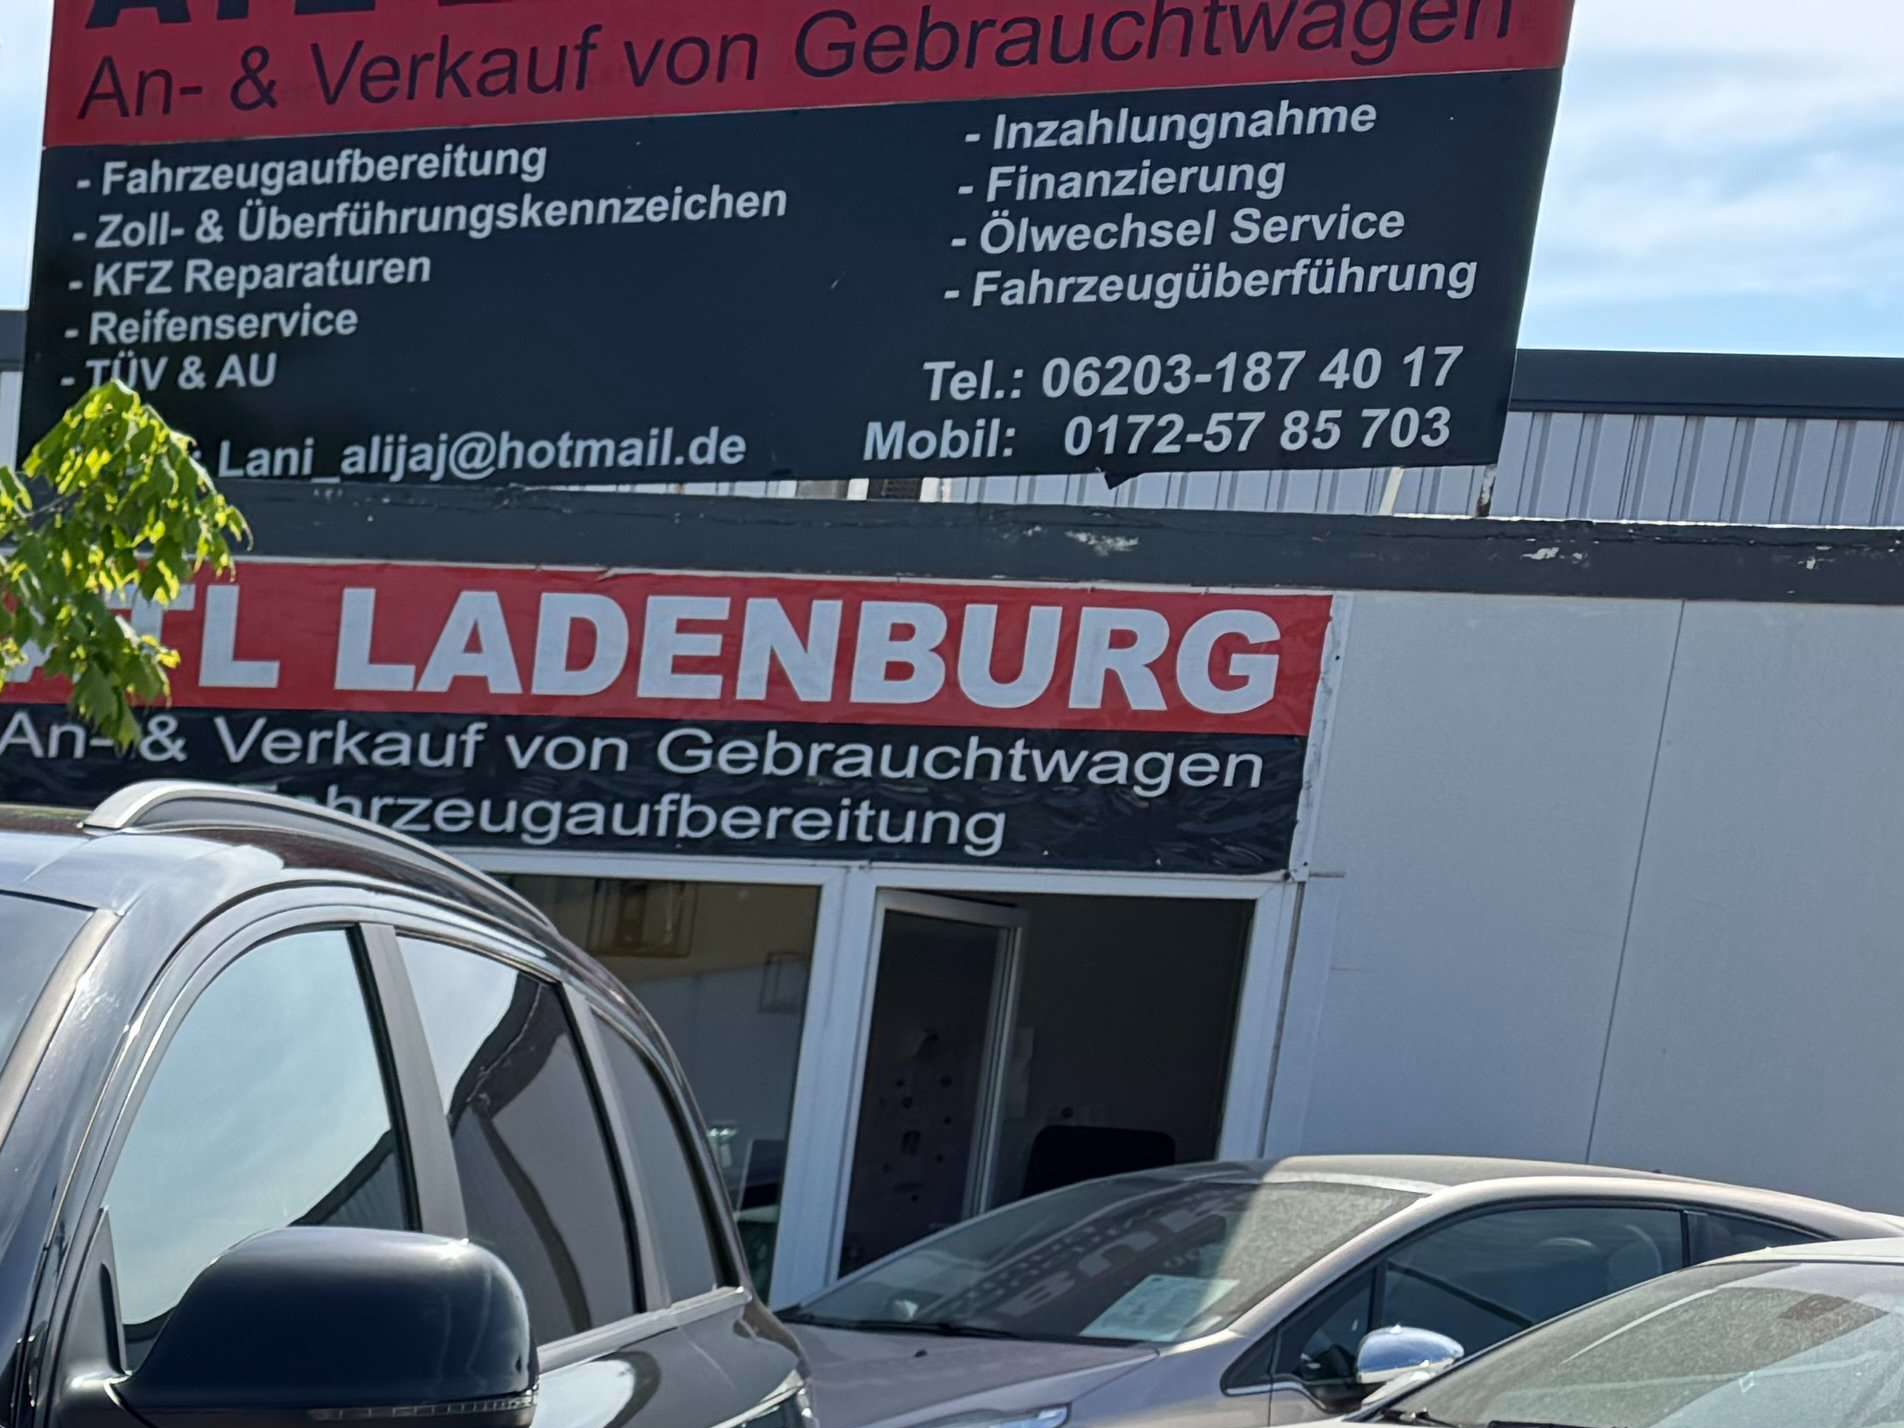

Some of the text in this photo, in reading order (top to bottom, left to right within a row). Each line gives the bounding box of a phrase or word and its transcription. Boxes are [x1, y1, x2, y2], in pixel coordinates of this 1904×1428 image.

[77, 0, 1512, 120] An- & Verkauf von Gebrauchtwagen
[993, 100, 1378, 151] Inzahlungnahme
[101, 143, 548, 196] Fahrzeugaufbereitung
[986, 158, 1287, 203] Finanzierung
[95, 212, 185, 250] Zoll-
[195, 209, 225, 246] &
[238, 183, 788, 244] Überführungskennzeichen
[979, 209, 1215, 256] Ölwechsel
[1230, 205, 1405, 246] Service
[94, 260, 172, 298] KFZ
[185, 253, 432, 297] Reparaturen
[972, 257, 1479, 310] Fahrzeugüberführung
[89, 303, 359, 346] Reifenservice
[85, 350, 169, 391] TÜV
[177, 355, 207, 390] &
[215, 352, 278, 389] AU
[922, 345, 1465, 402] Tel.: 06203-187 40 17
[218, 427, 746, 482] Lani_alijaj@hotmail.de
[862, 406, 1452, 462] Mobil: 0172-57 85 703
[3, 584, 1282, 715] TL LADENBURG
[137, 713, 188, 762] &
[213, 716, 488, 768] Verkauf
[504, 730, 630, 772] von
[656, 725, 1264, 799] Gebrauchtwagen
[237, 783, 1008, 858] hrzeugaufbereitung
